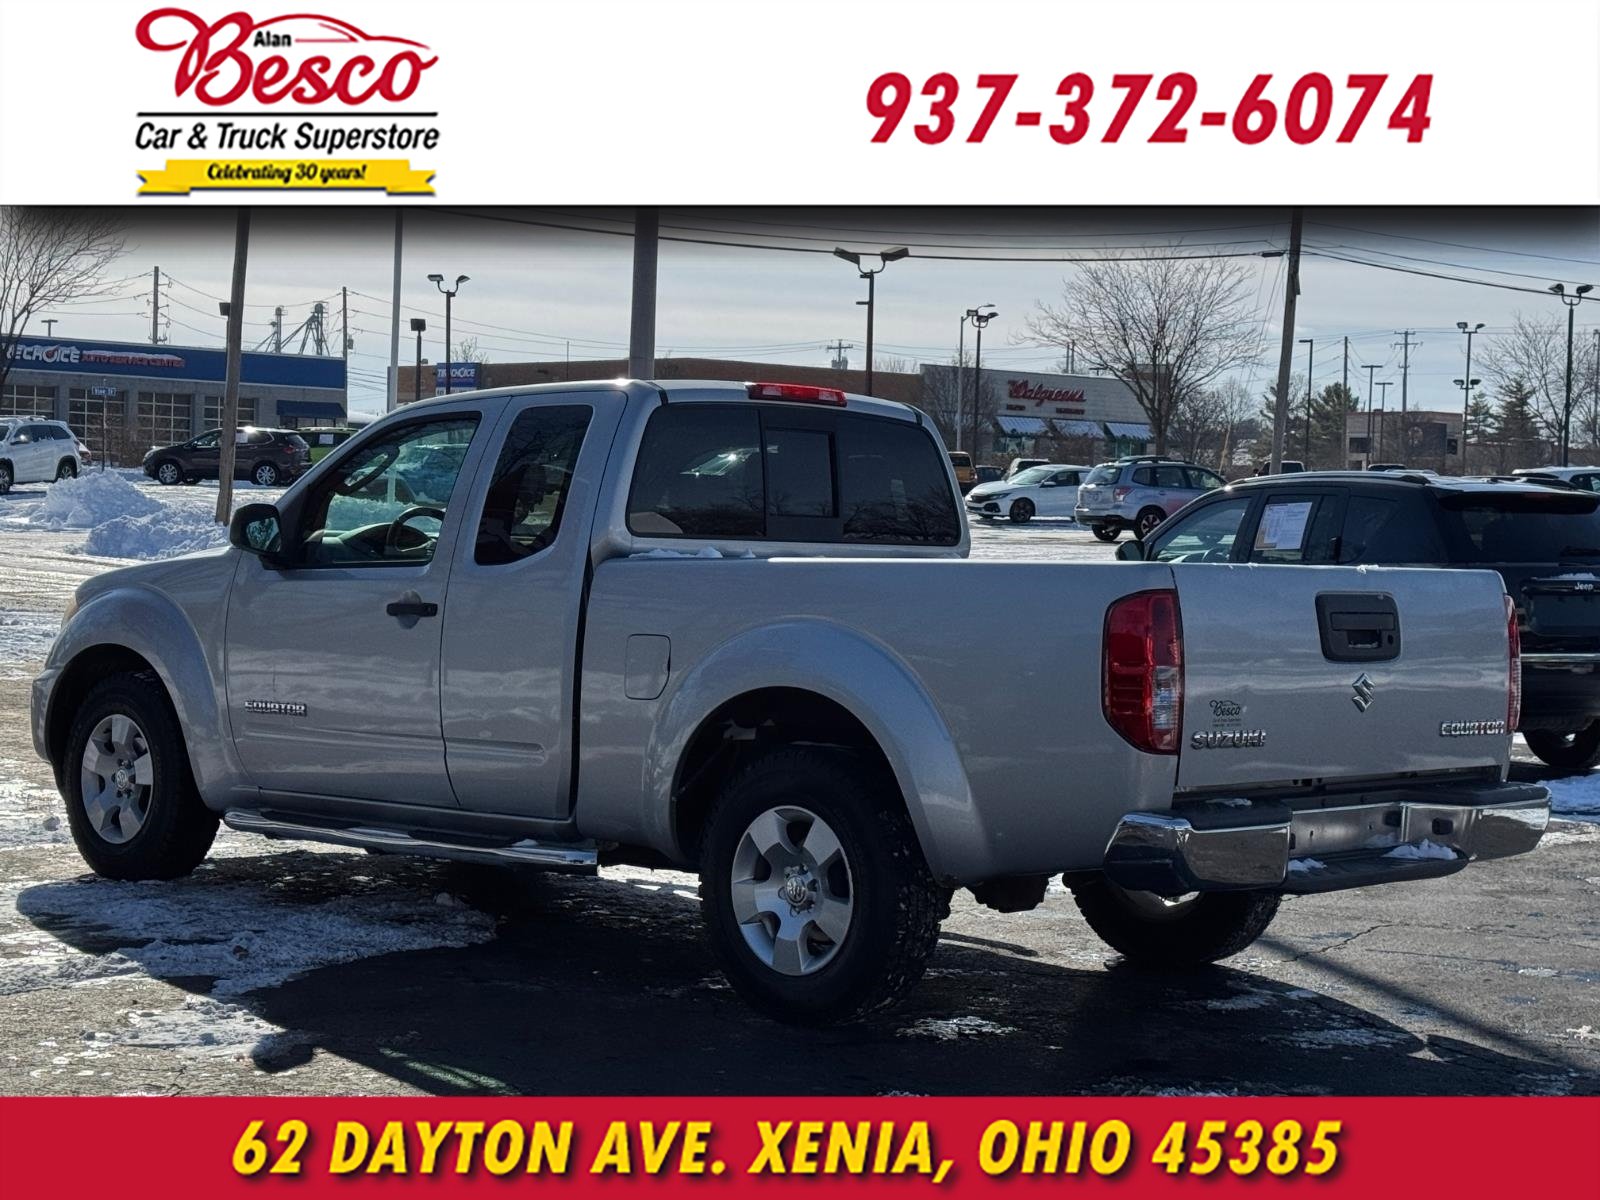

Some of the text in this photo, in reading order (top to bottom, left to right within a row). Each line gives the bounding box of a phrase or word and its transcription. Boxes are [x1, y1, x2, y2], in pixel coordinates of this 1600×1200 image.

[1008, 379, 1087, 407] Walgreens
[1574, 582, 1594, 592] Jeep
[1440, 720, 1505, 736] EQUATOR
[1191, 730, 1266, 750] SUZUKI
